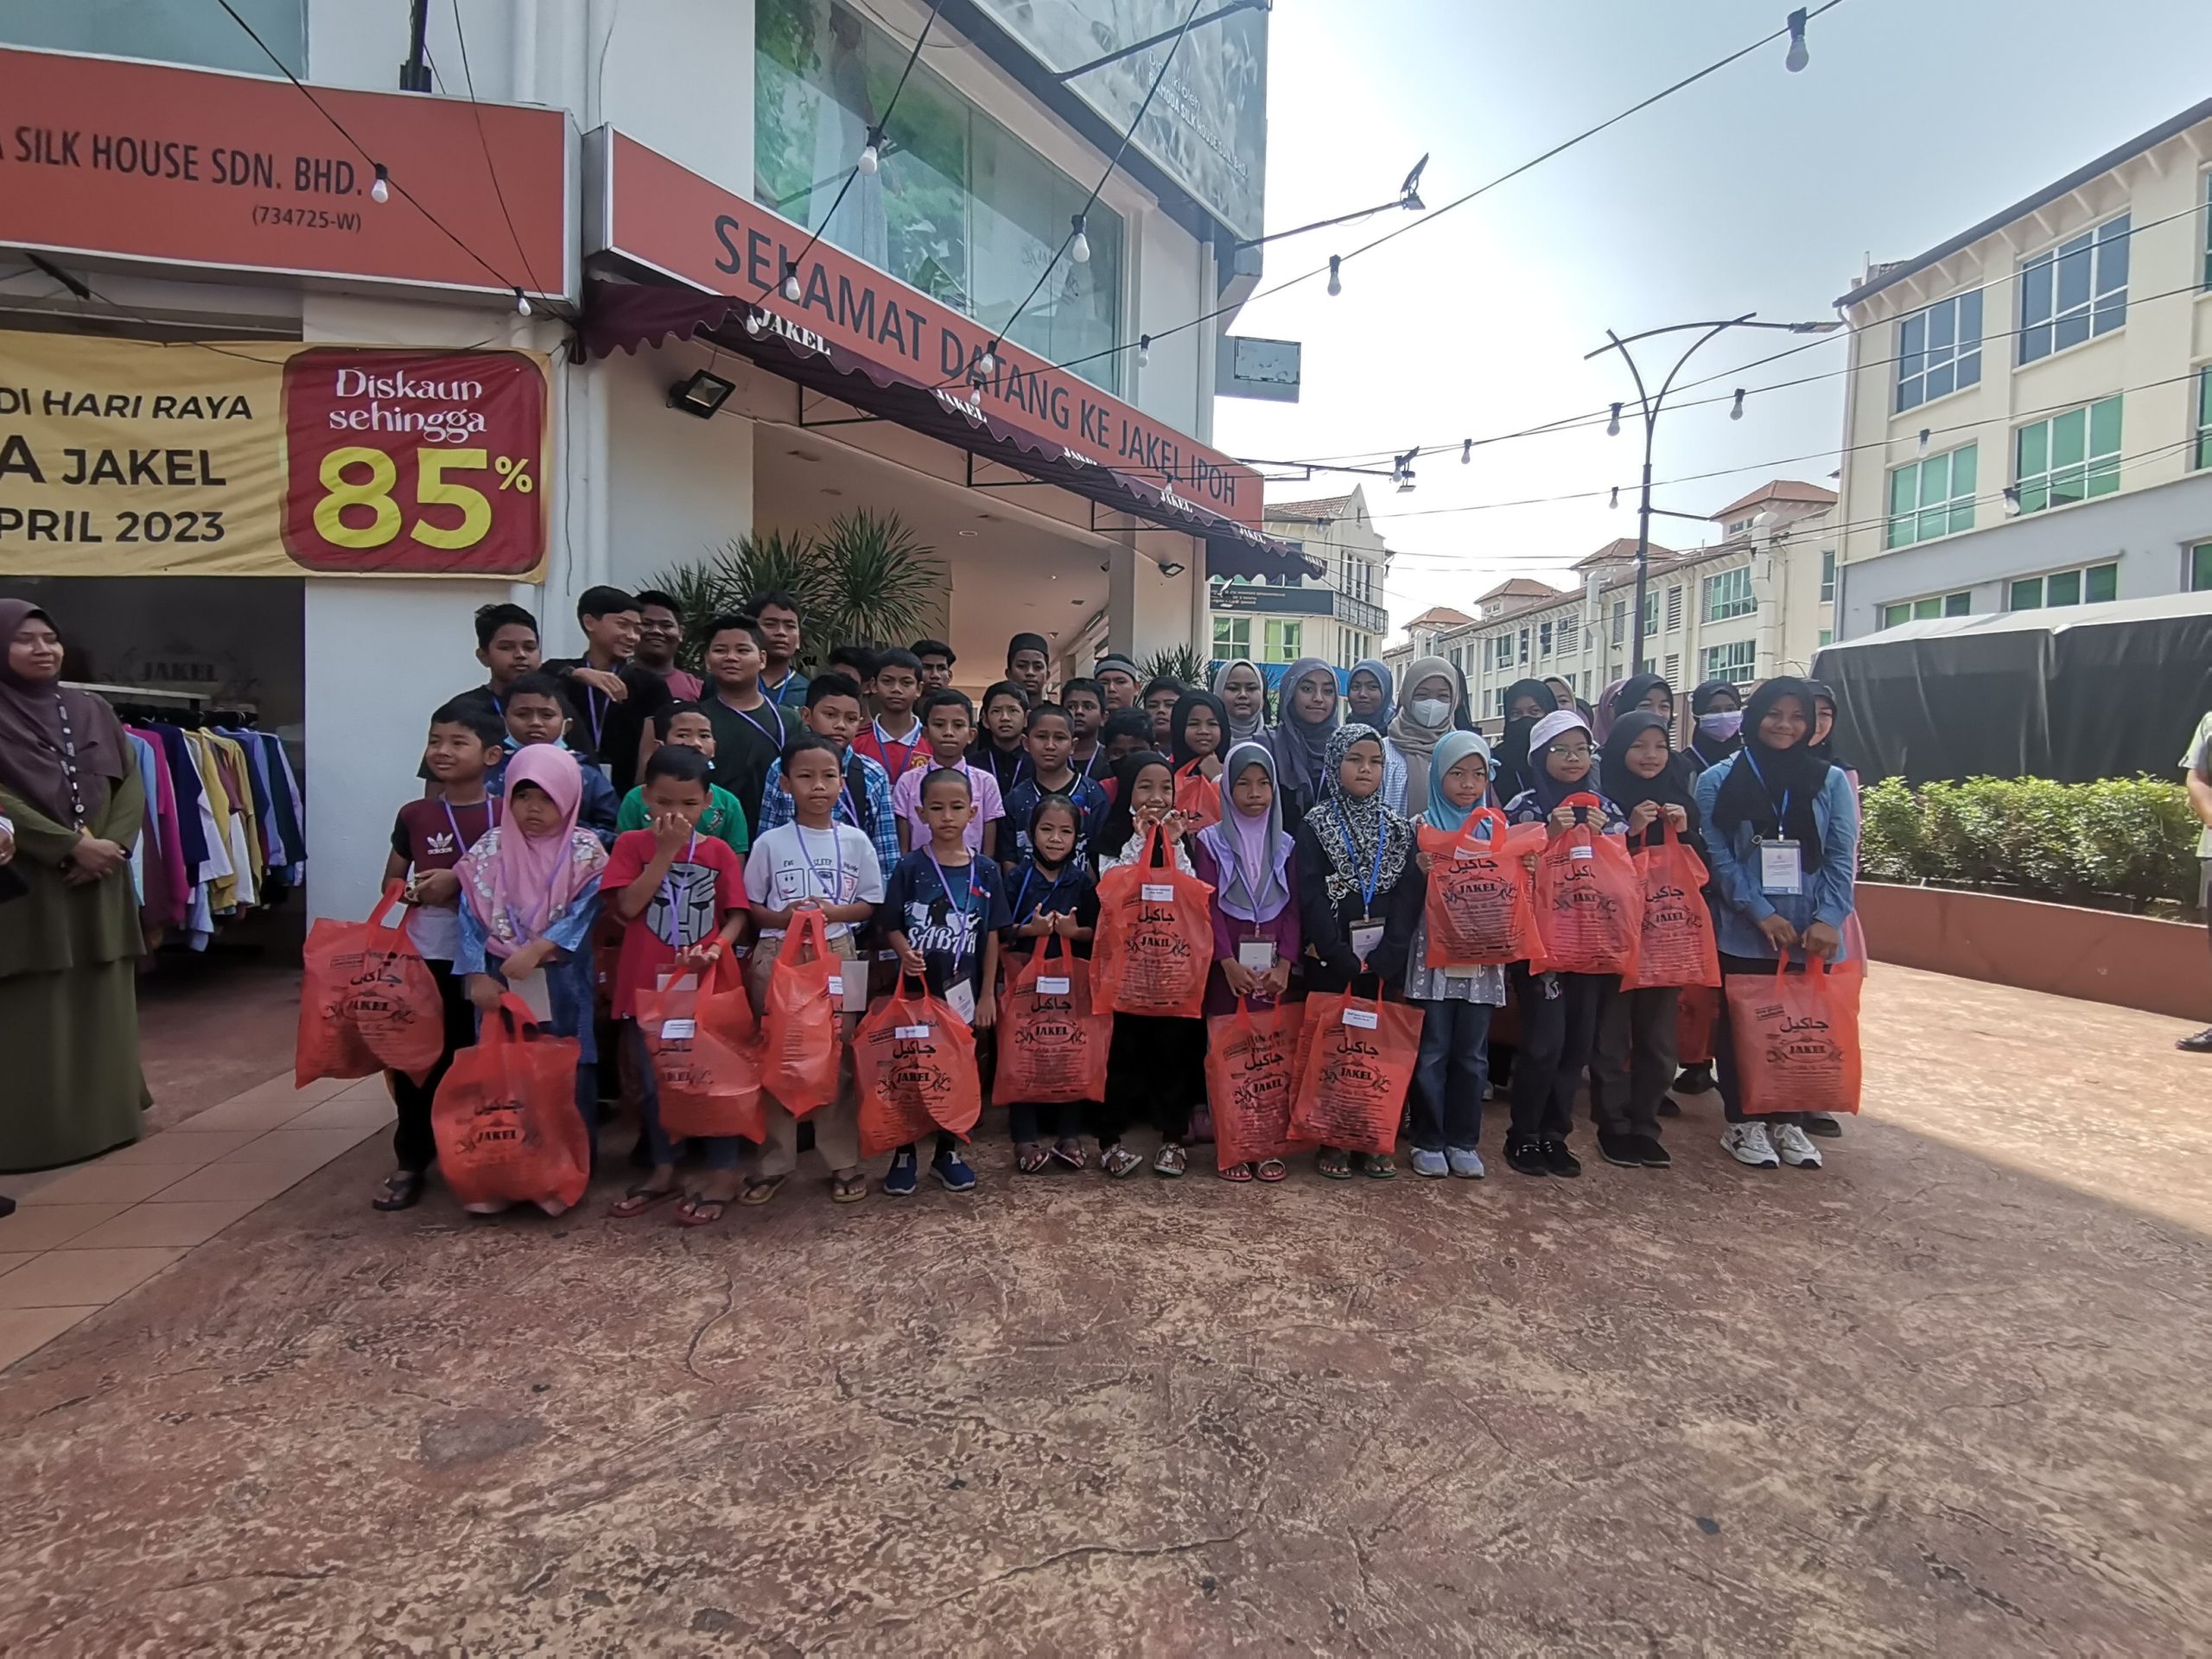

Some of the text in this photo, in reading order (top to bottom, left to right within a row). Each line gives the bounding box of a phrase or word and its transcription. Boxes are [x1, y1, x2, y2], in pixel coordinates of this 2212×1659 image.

[15, 125, 363, 196] SILK HOUSE SDN. BHD.
[251, 205, 362, 233] (734725-W)
[755, 308, 830, 356] JAKEL
[714, 213, 1236, 507] SELAMAT DATANG KE JAKEL IPOH
[335, 367, 482, 401] Diskaun
[43, 390, 143, 419] HARI
[151, 395, 253, 420] RAYA
[329, 401, 487, 443] sehingga
[61, 448, 226, 486] JAKEL
[116, 512, 225, 543] 2023
[1565, 865, 1596, 881] اكيل
[1459, 883, 1497, 895] JAKEL
[1036, 1026, 1070, 1036] JAKEL
[1254, 1077, 1283, 1094] JAKEL
[1340, 1067, 1373, 1081] JAKEL
